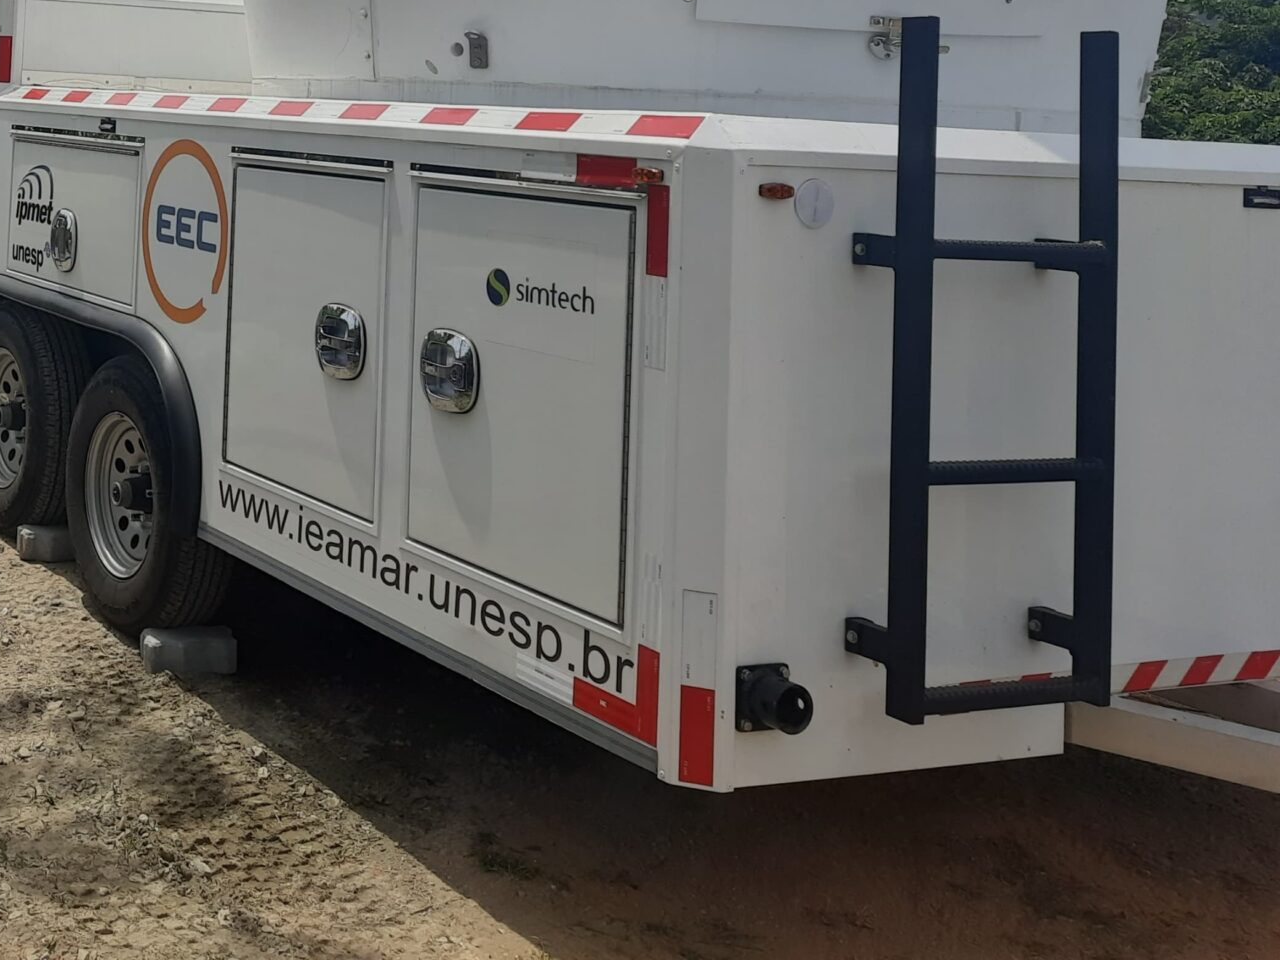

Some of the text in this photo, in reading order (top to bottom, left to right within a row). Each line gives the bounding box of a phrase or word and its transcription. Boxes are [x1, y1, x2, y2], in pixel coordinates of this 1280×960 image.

[16, 193, 53, 225] ipmet
[156, 204, 218, 253] EEC
[12, 243, 43, 272] unesp
[516, 277, 594, 314] simtech
[219, 480, 634, 693] www.ieamar.unesp.br
